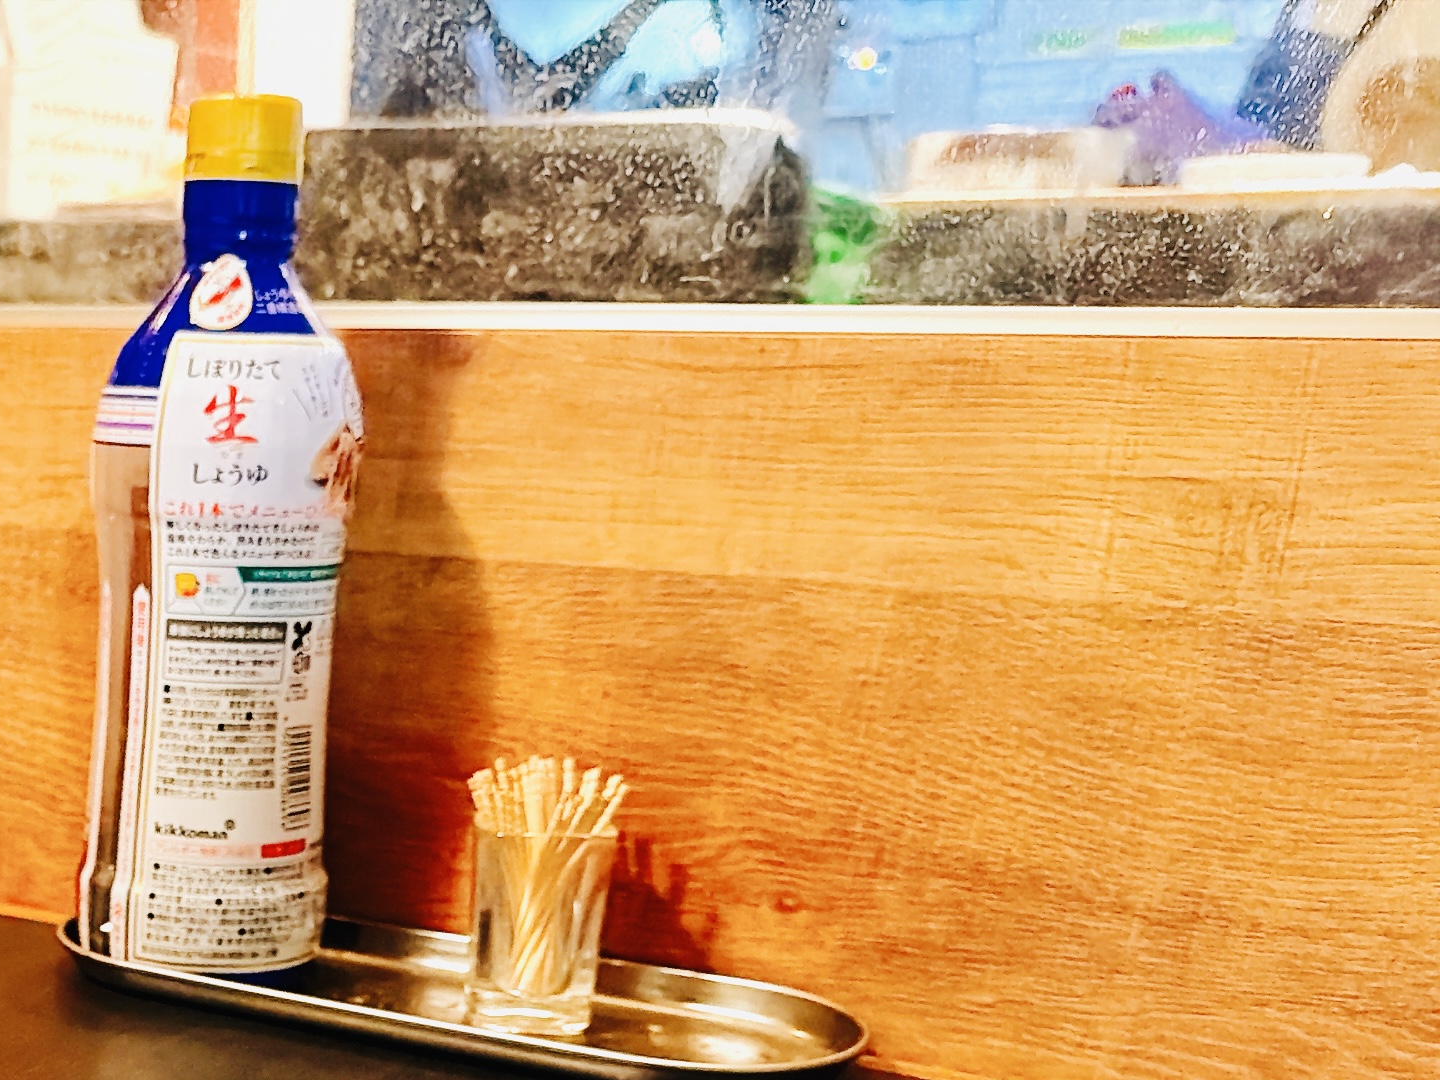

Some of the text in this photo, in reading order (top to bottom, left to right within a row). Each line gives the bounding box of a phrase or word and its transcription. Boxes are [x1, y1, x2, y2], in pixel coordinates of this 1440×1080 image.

[187, 357, 282, 380] しぼりたて
[203, 384, 259, 444] 生
[192, 463, 268, 486] しょうゆ
